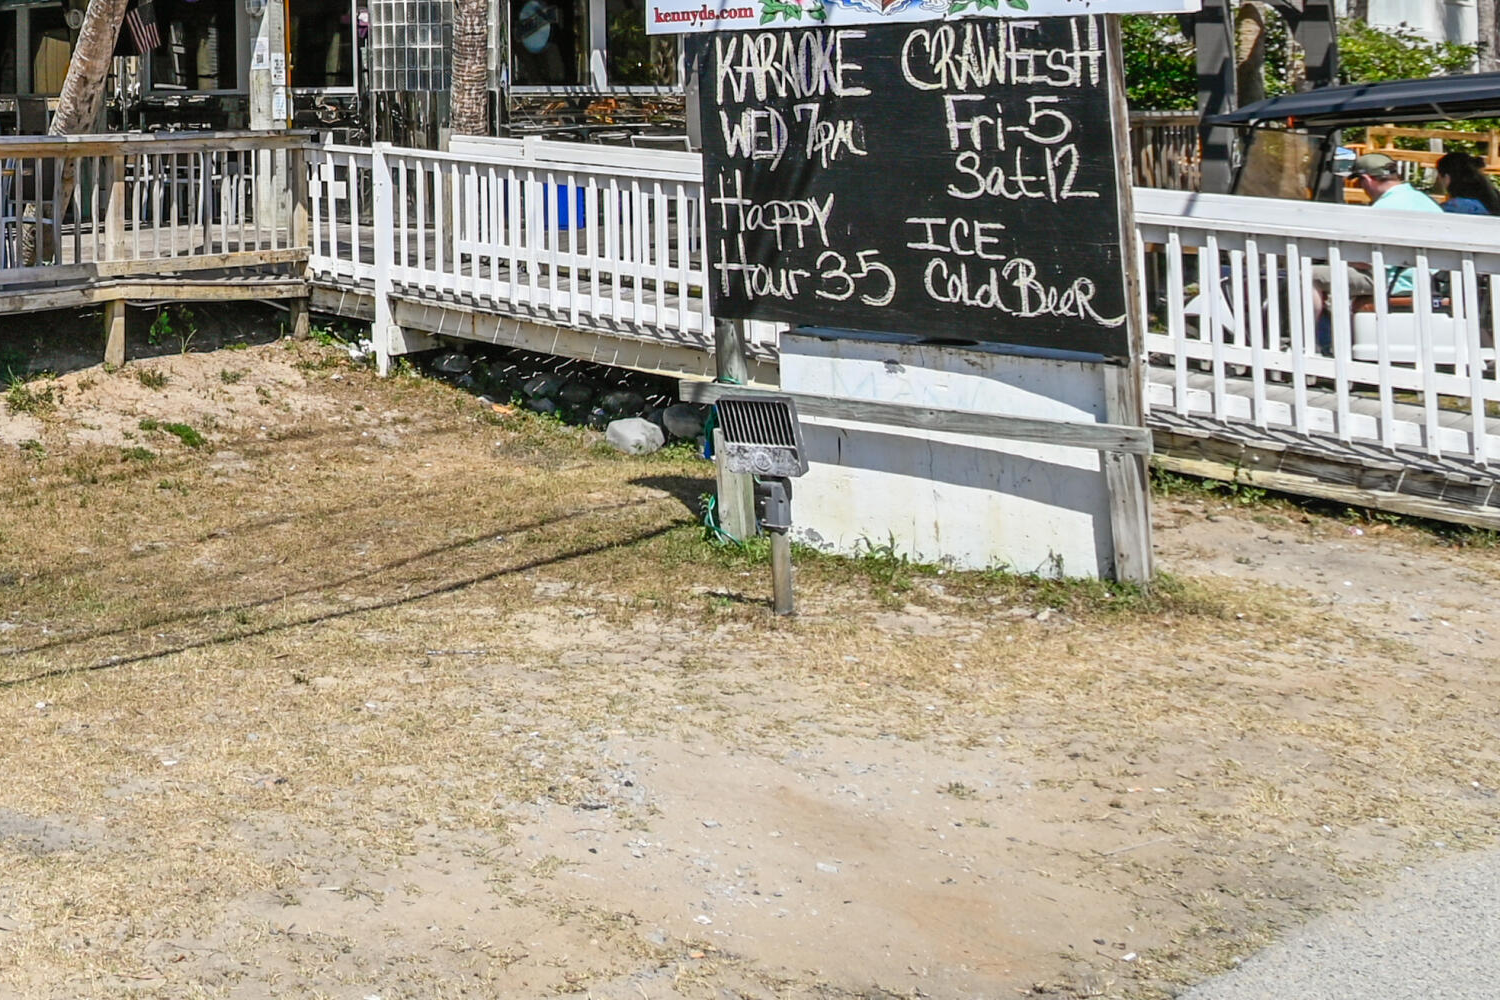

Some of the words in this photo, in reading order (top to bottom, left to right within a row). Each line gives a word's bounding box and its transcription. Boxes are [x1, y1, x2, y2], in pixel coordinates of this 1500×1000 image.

[653, 4, 754, 27] kennyds.com
[715, 29, 872, 106] KARAOKE
[901, 14, 1104, 92] CRAWFISH
[718, 106, 788, 171] WED
[905, 217, 1006, 260] ICE
